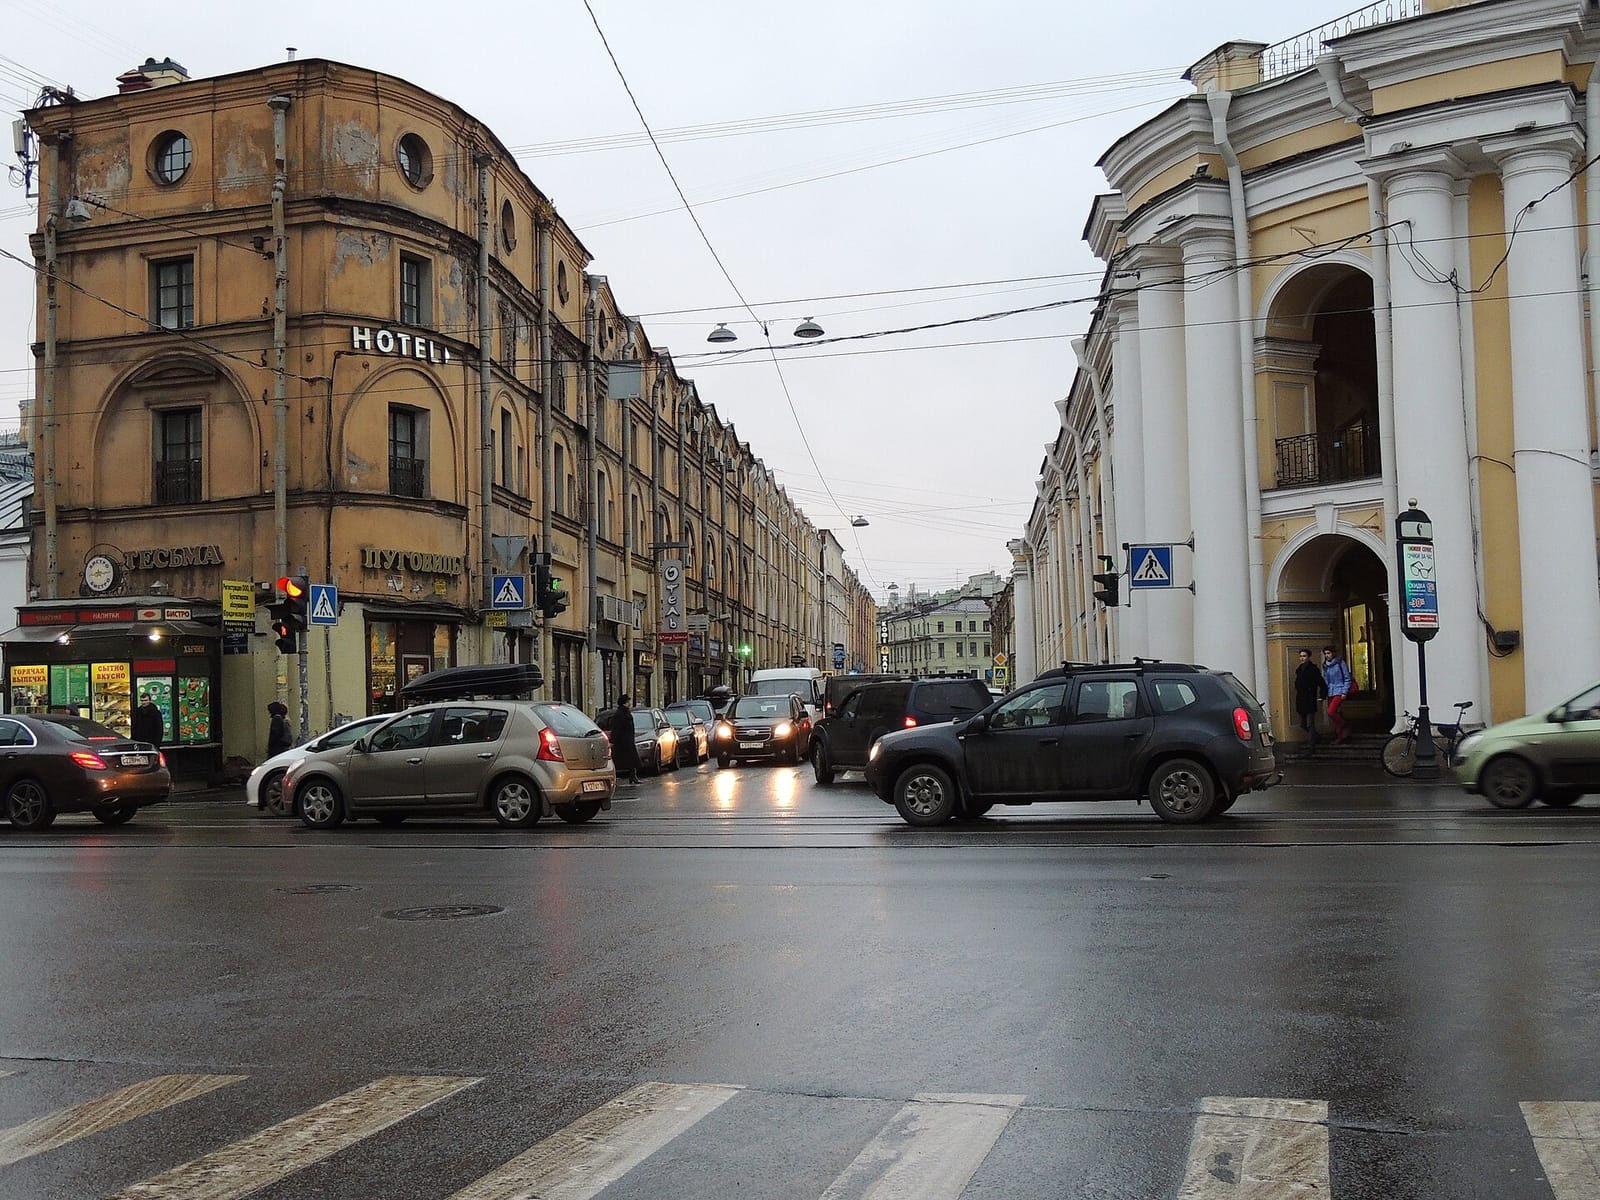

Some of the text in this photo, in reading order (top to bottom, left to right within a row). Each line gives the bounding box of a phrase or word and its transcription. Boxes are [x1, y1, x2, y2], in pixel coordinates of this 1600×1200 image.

[353, 326, 440, 363] HOTEL
[124, 545, 224, 571] ТЕСЬМА
[92, 612, 120, 620] НАПИТКИ
[166, 610, 190, 618] БИСТРО
[13, 668, 45, 676] ГОРЯЧАЯ
[97, 664, 124, 672] СЫТНО
[12, 675, 47, 683] ВЫПЕЧКА
[96, 672, 126, 680] ВКУСНО
